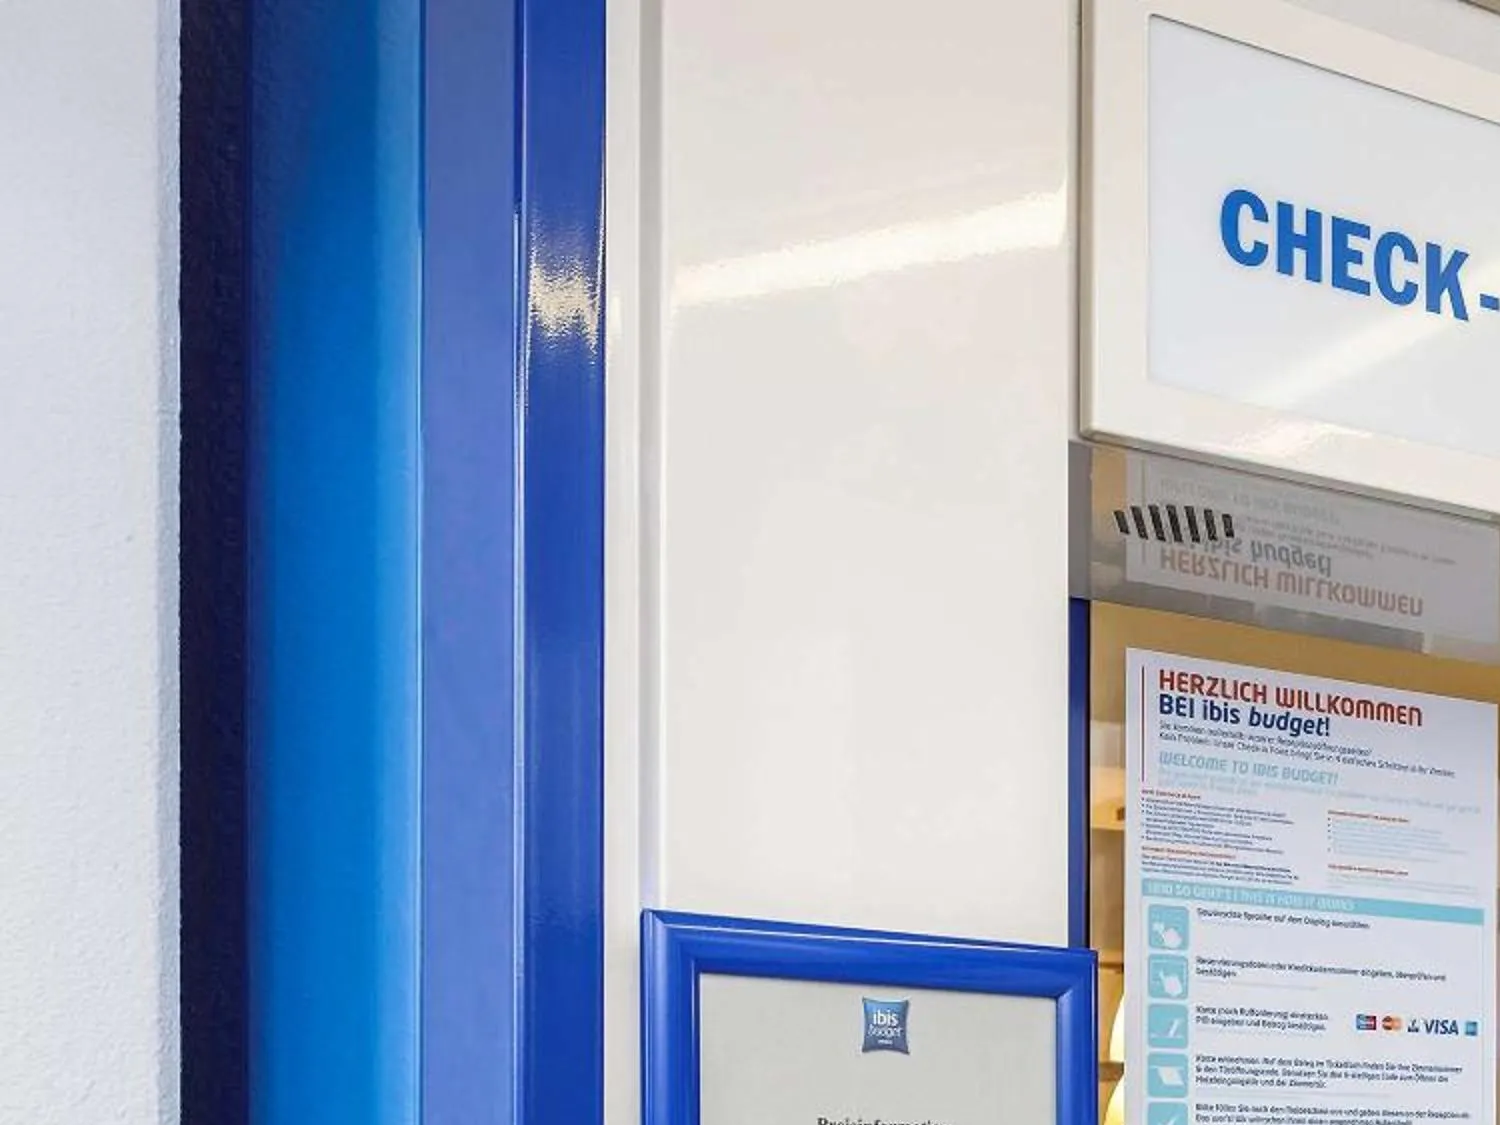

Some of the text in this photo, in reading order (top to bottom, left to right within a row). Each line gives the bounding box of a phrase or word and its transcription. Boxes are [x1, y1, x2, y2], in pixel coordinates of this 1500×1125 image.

[1159, 669, 1423, 727] HERZLICH WILLKOMMEN
[1159, 693, 1331, 737] BEI ibis budget!
[1159, 752, 1339, 786] WELCOME TO IBIS BUDGET!
[873, 1009, 899, 1027] ibis
[1423, 1019, 1460, 1036] VISA
